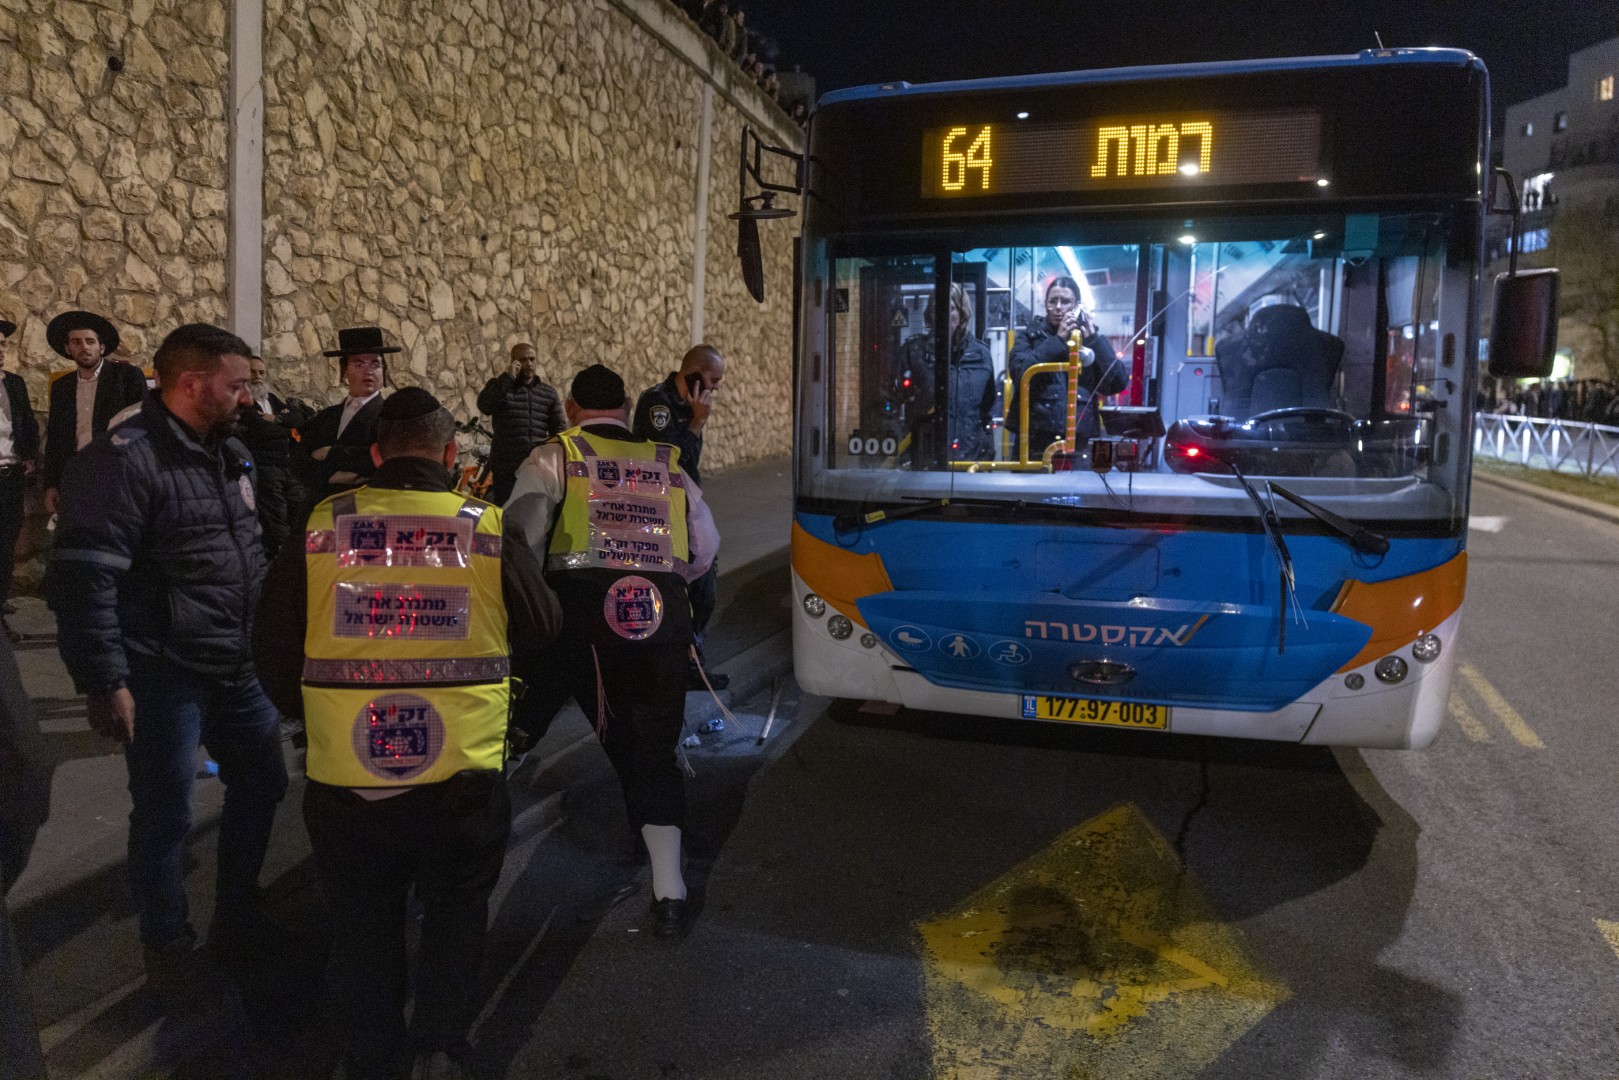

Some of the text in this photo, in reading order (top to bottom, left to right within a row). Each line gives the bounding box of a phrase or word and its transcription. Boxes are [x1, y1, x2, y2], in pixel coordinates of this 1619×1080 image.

[1091, 121, 1212, 177] רמות
[942, 126, 992, 191] 64
[849, 437, 896, 455] 000
[596, 509, 665, 525] משטרת ישראל
[627, 504, 656, 515] מתנדב
[631, 541, 659, 552] מפקד
[599, 549, 663, 564] מחוז ירושלים
[343, 610, 393, 625] ישראל
[1025, 620, 1189, 648] אקסטרה
